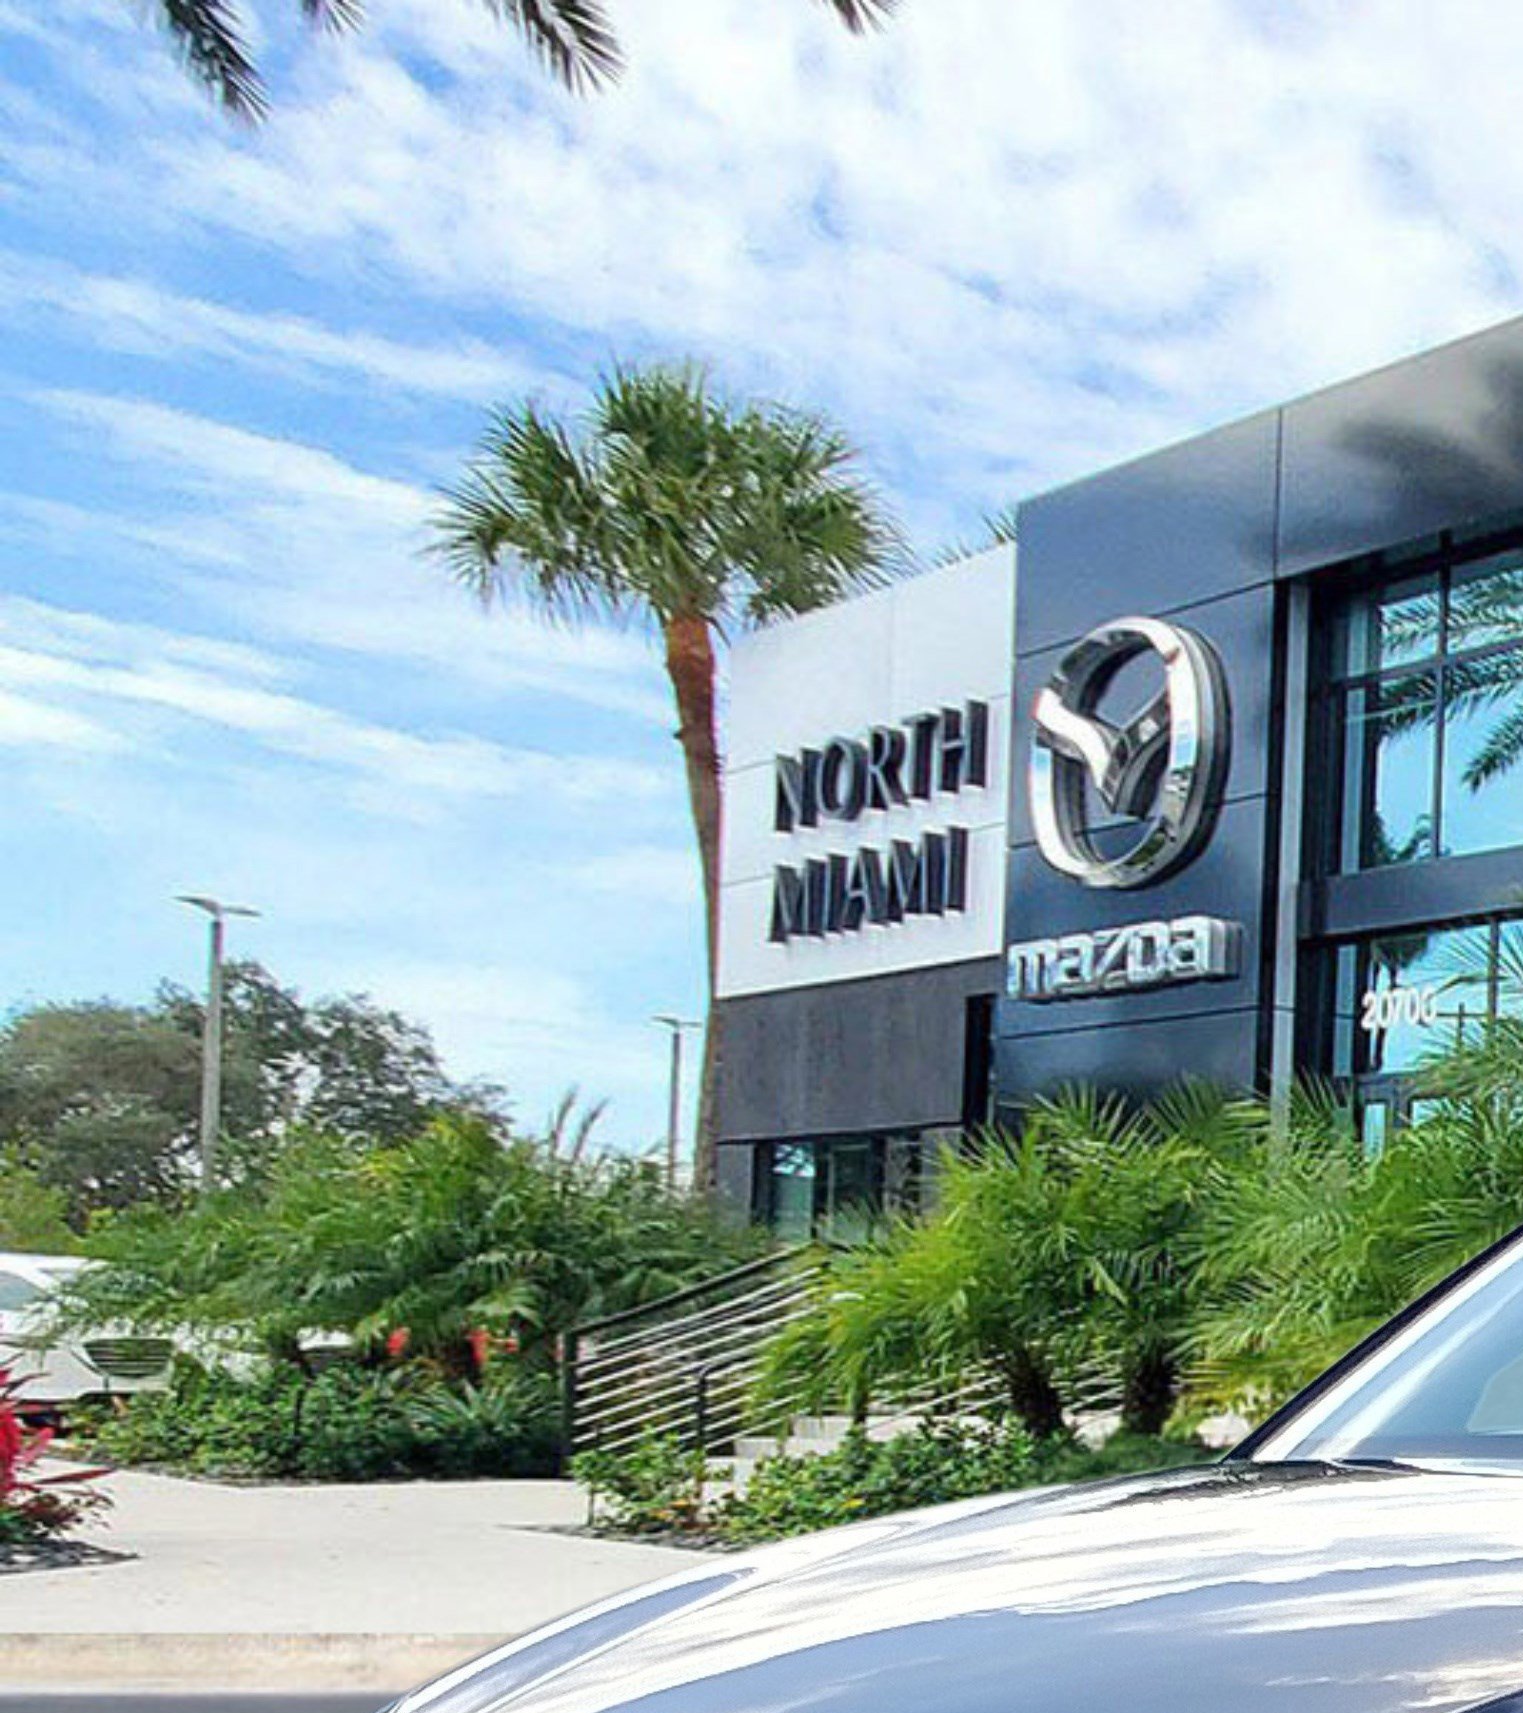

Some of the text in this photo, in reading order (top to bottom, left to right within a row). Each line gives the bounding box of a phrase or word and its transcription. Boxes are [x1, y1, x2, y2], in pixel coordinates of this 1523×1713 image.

[774, 698, 988, 833] NORTH
[769, 826, 968, 943] MIAMI
[1006, 914, 1241, 1002] mazda
